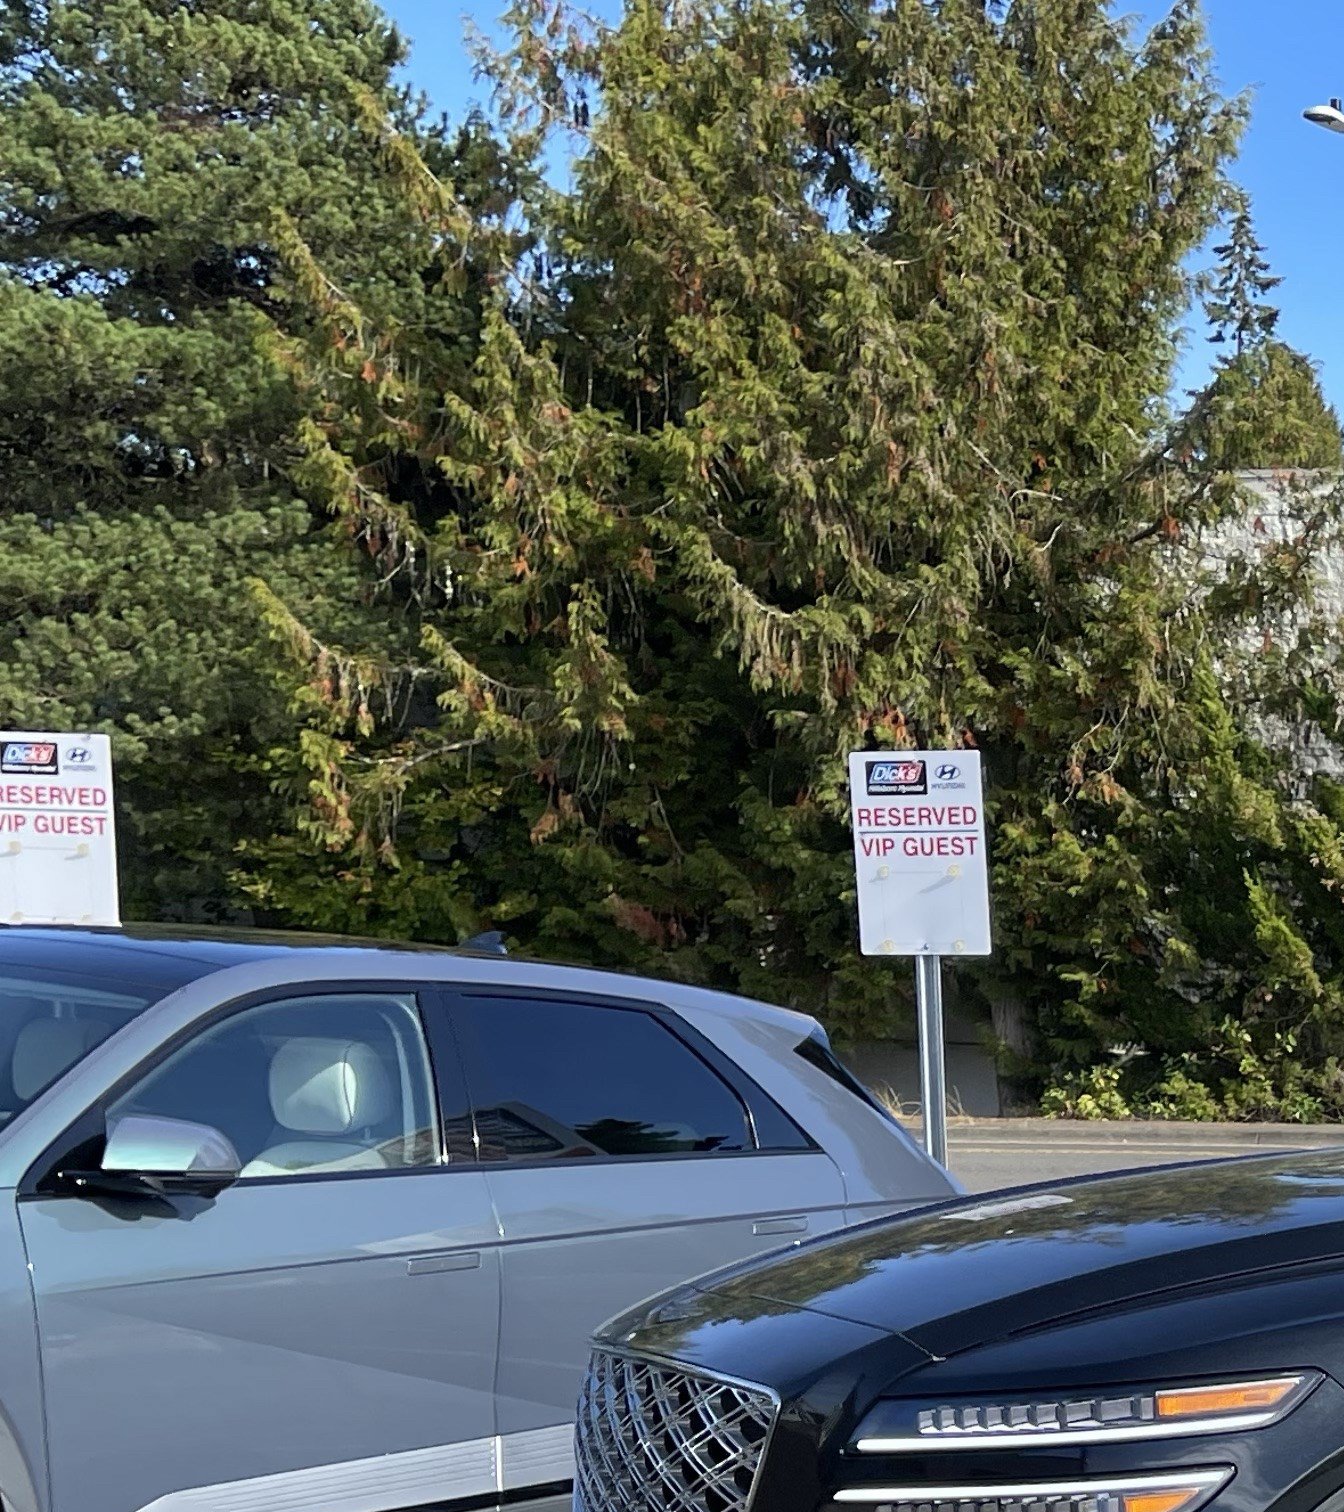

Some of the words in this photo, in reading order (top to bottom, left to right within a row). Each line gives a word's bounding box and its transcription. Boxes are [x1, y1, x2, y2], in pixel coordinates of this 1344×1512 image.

[0, 785, 107, 806] ESERVED
[34, 815, 107, 835] GUEST
[857, 807, 977, 827] RESERVED
[860, 838, 895, 857] VIP
[903, 837, 978, 856] GUEST
